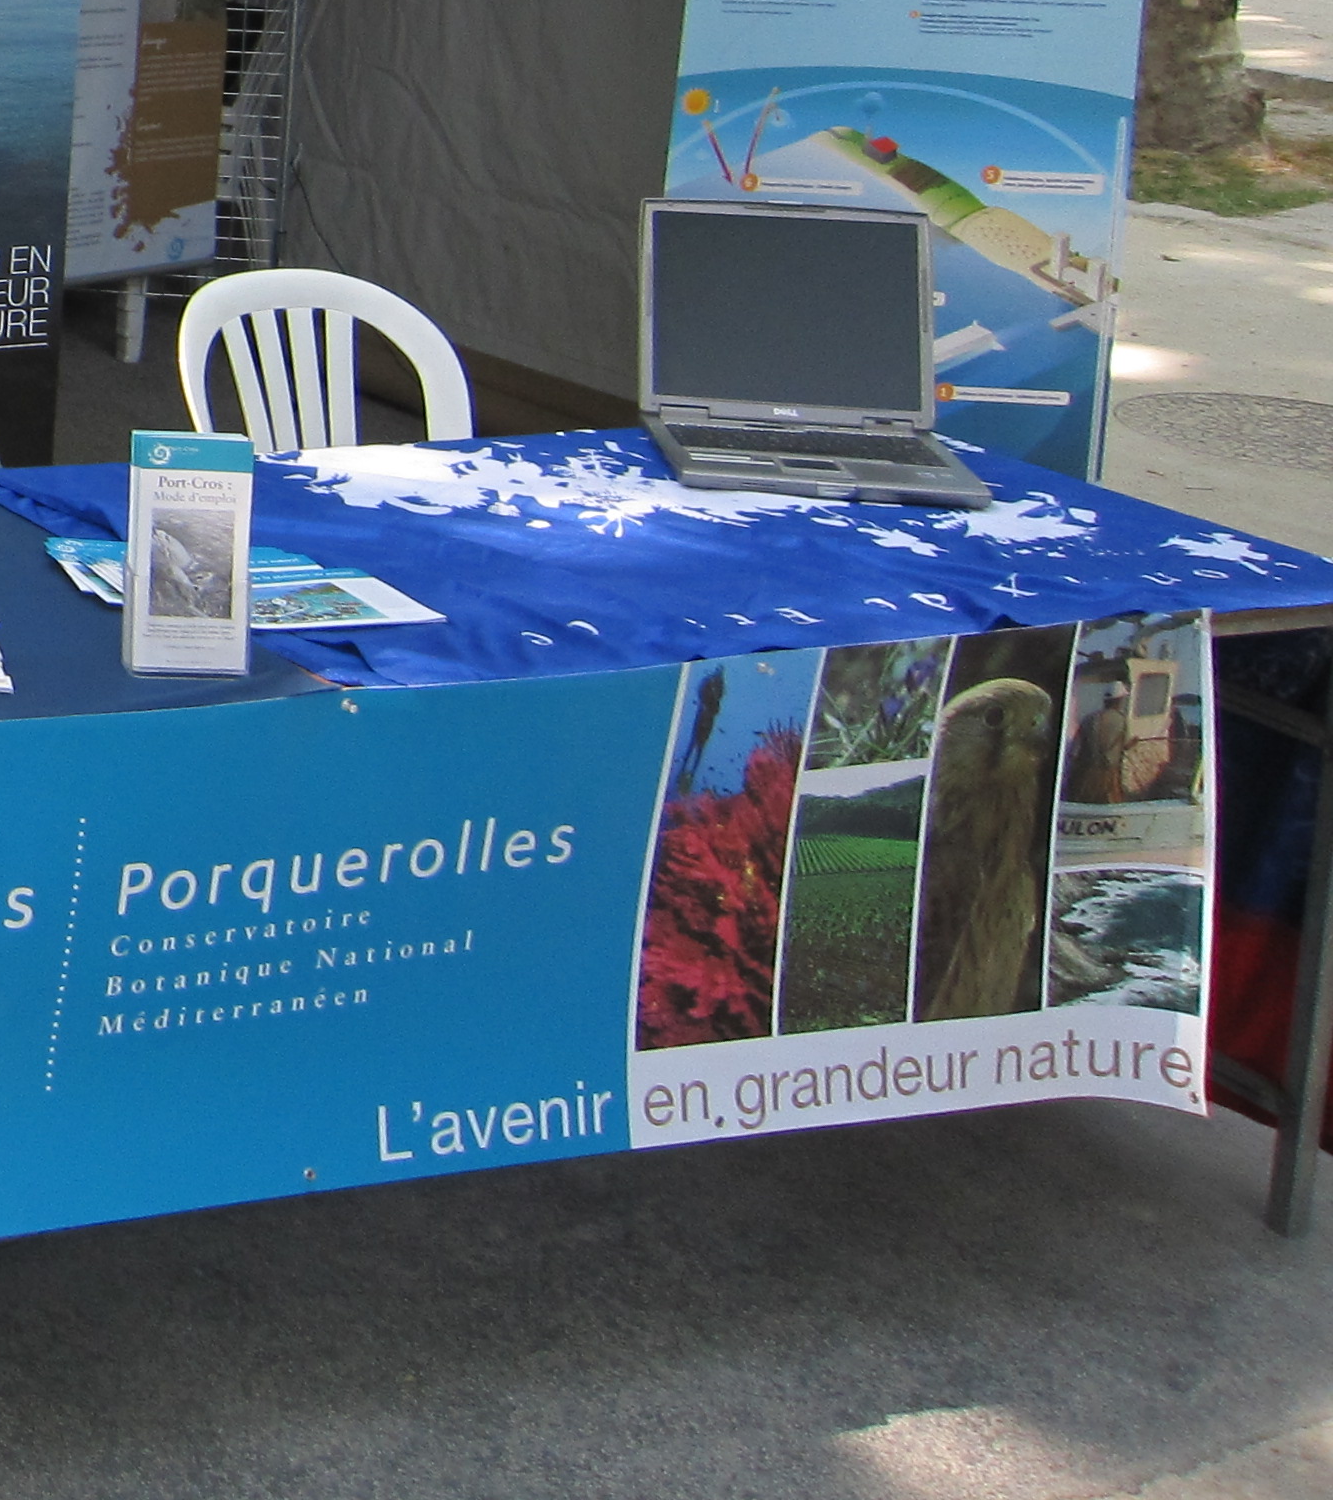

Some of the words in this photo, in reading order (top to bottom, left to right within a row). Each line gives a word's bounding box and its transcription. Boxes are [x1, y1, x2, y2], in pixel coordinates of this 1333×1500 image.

[9, 244, 52, 276] EN
[152, 490, 186, 503] Mode
[187, 491, 237, 506] d'emploi
[157, 475, 225, 491] Port-Cros
[1058, 818, 1117, 837] ULON
[115, 814, 578, 918] Porquerolles
[110, 906, 375, 959] Conservatoire
[103, 951, 296, 1000] Botanique
[311, 928, 478, 981] National
[96, 982, 374, 1040] Méditerranéen
[374, 1080, 614, 1164] L'avenir
[643, 1077, 715, 1129] en
[734, 1043, 981, 1133] grandeur
[993, 1027, 1194, 1088] nature
